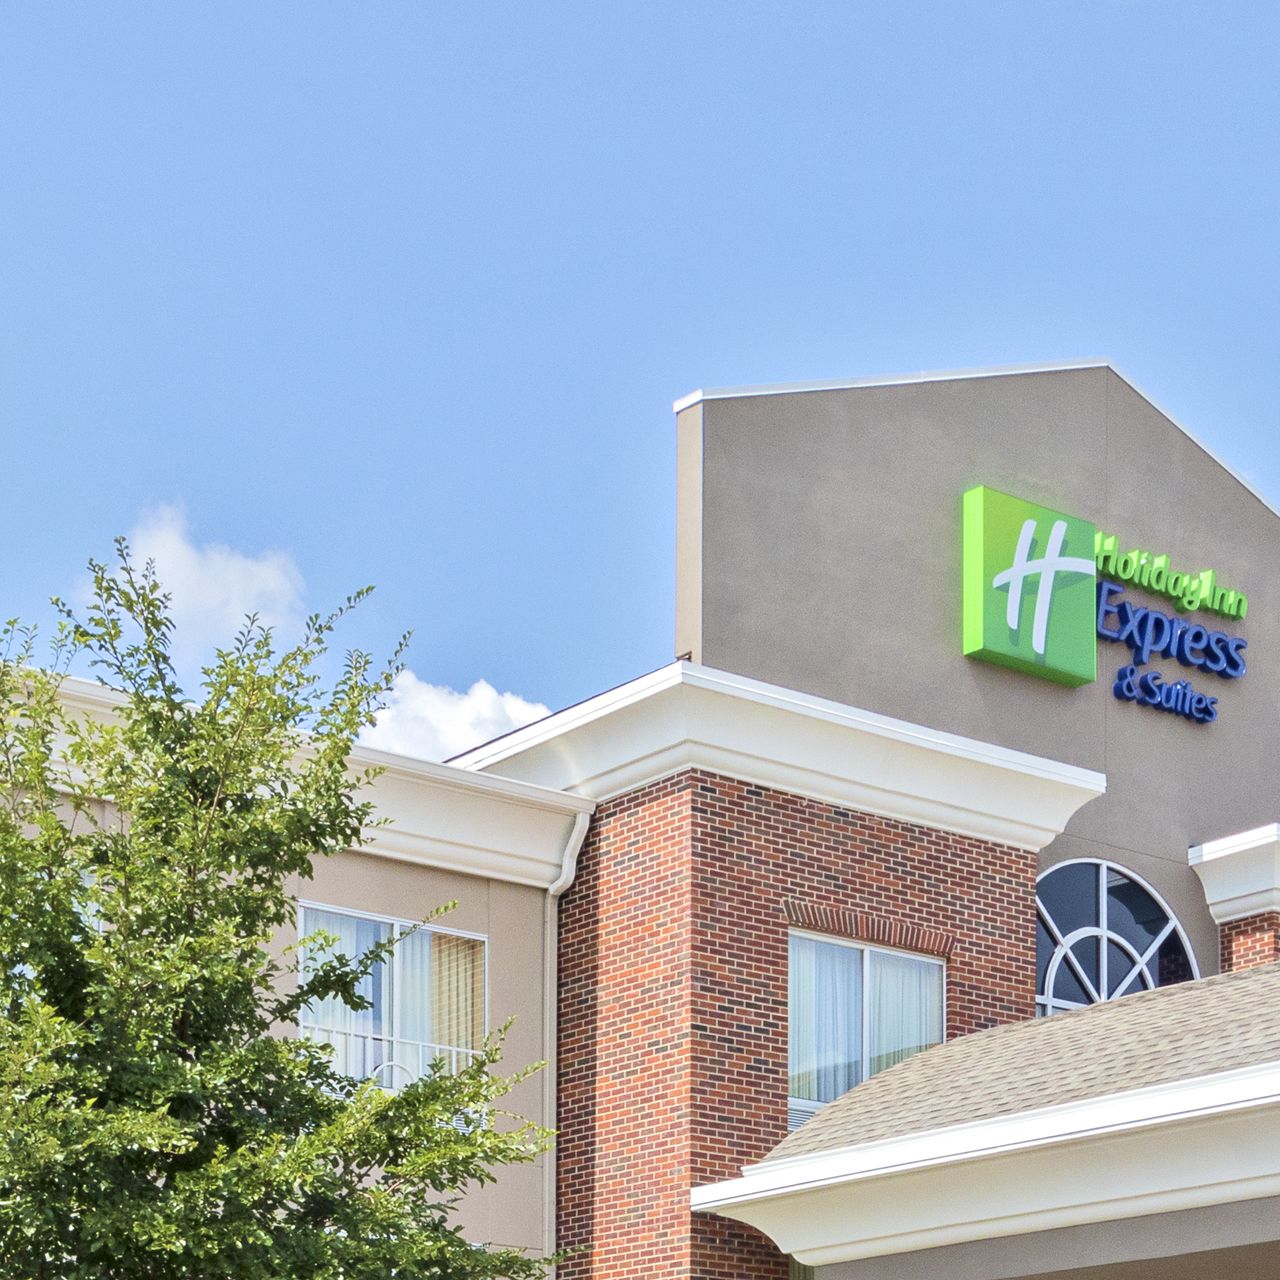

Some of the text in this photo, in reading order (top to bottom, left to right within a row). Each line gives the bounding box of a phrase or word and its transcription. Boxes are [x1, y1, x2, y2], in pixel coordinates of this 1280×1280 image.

[993, 519, 1096, 654] H
[1095, 531, 1248, 620] Holiday Inn
[1097, 580, 1247, 679] Express
[1137, 671, 1218, 723] Suites
